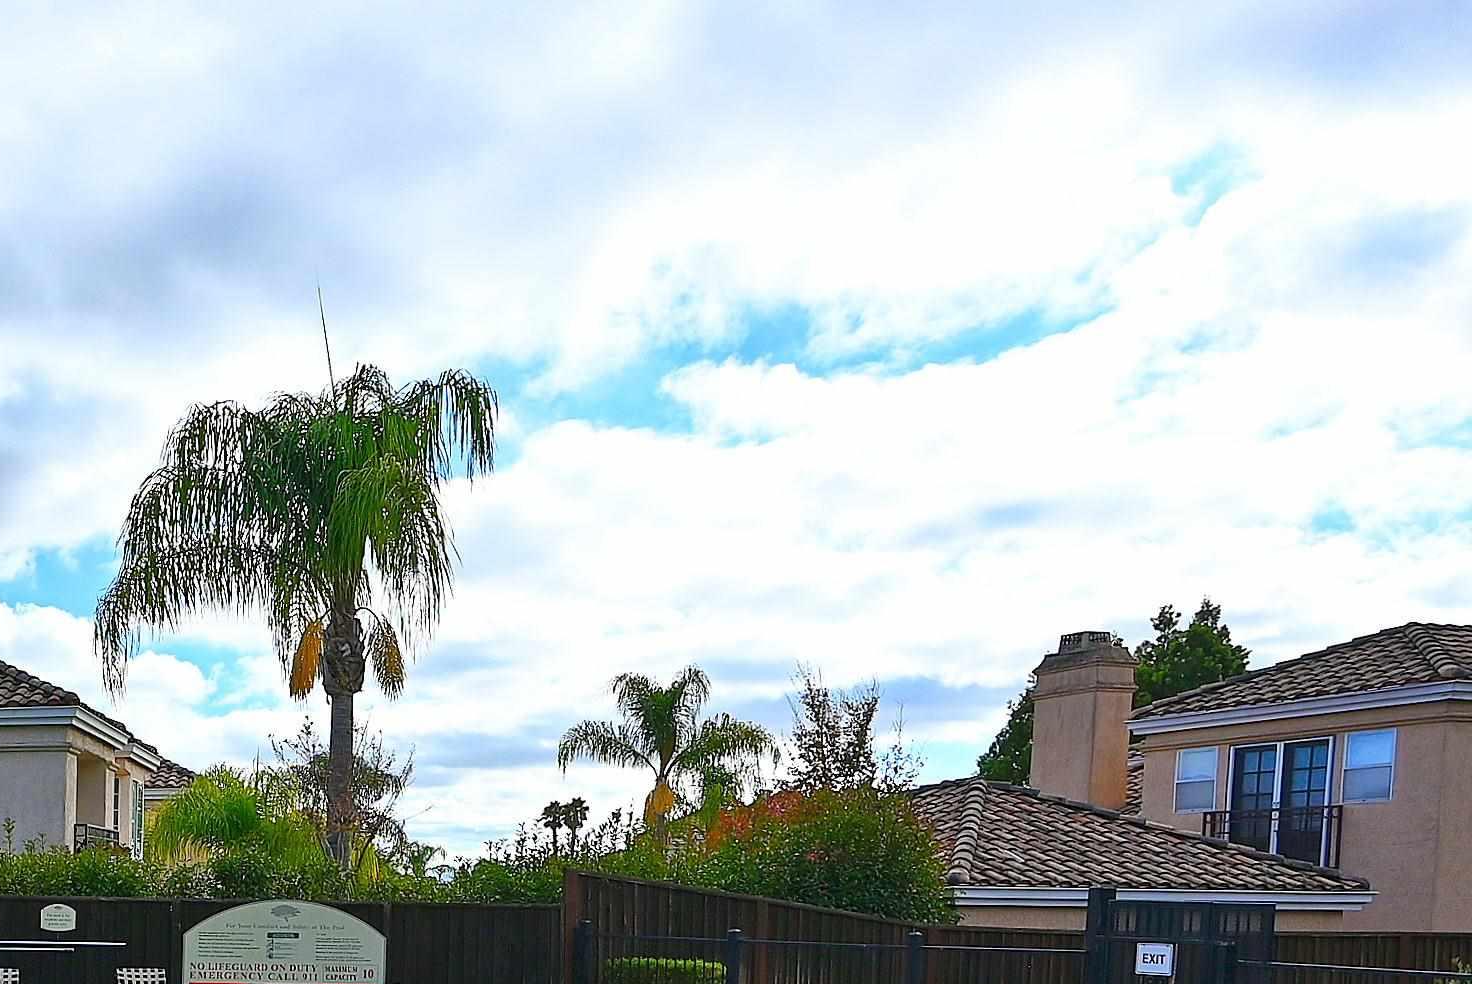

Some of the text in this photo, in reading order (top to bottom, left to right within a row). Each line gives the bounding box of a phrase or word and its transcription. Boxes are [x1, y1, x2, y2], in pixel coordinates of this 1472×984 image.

[1142, 953, 1166, 965] EXIT
[189, 962, 317, 973] NO LIFEGUARD ON DUTY
[325, 965, 358, 973] MAXIMUM
[189, 971, 318, 982] EMERGENCY CALL 911
[363, 969, 374, 979] 10
